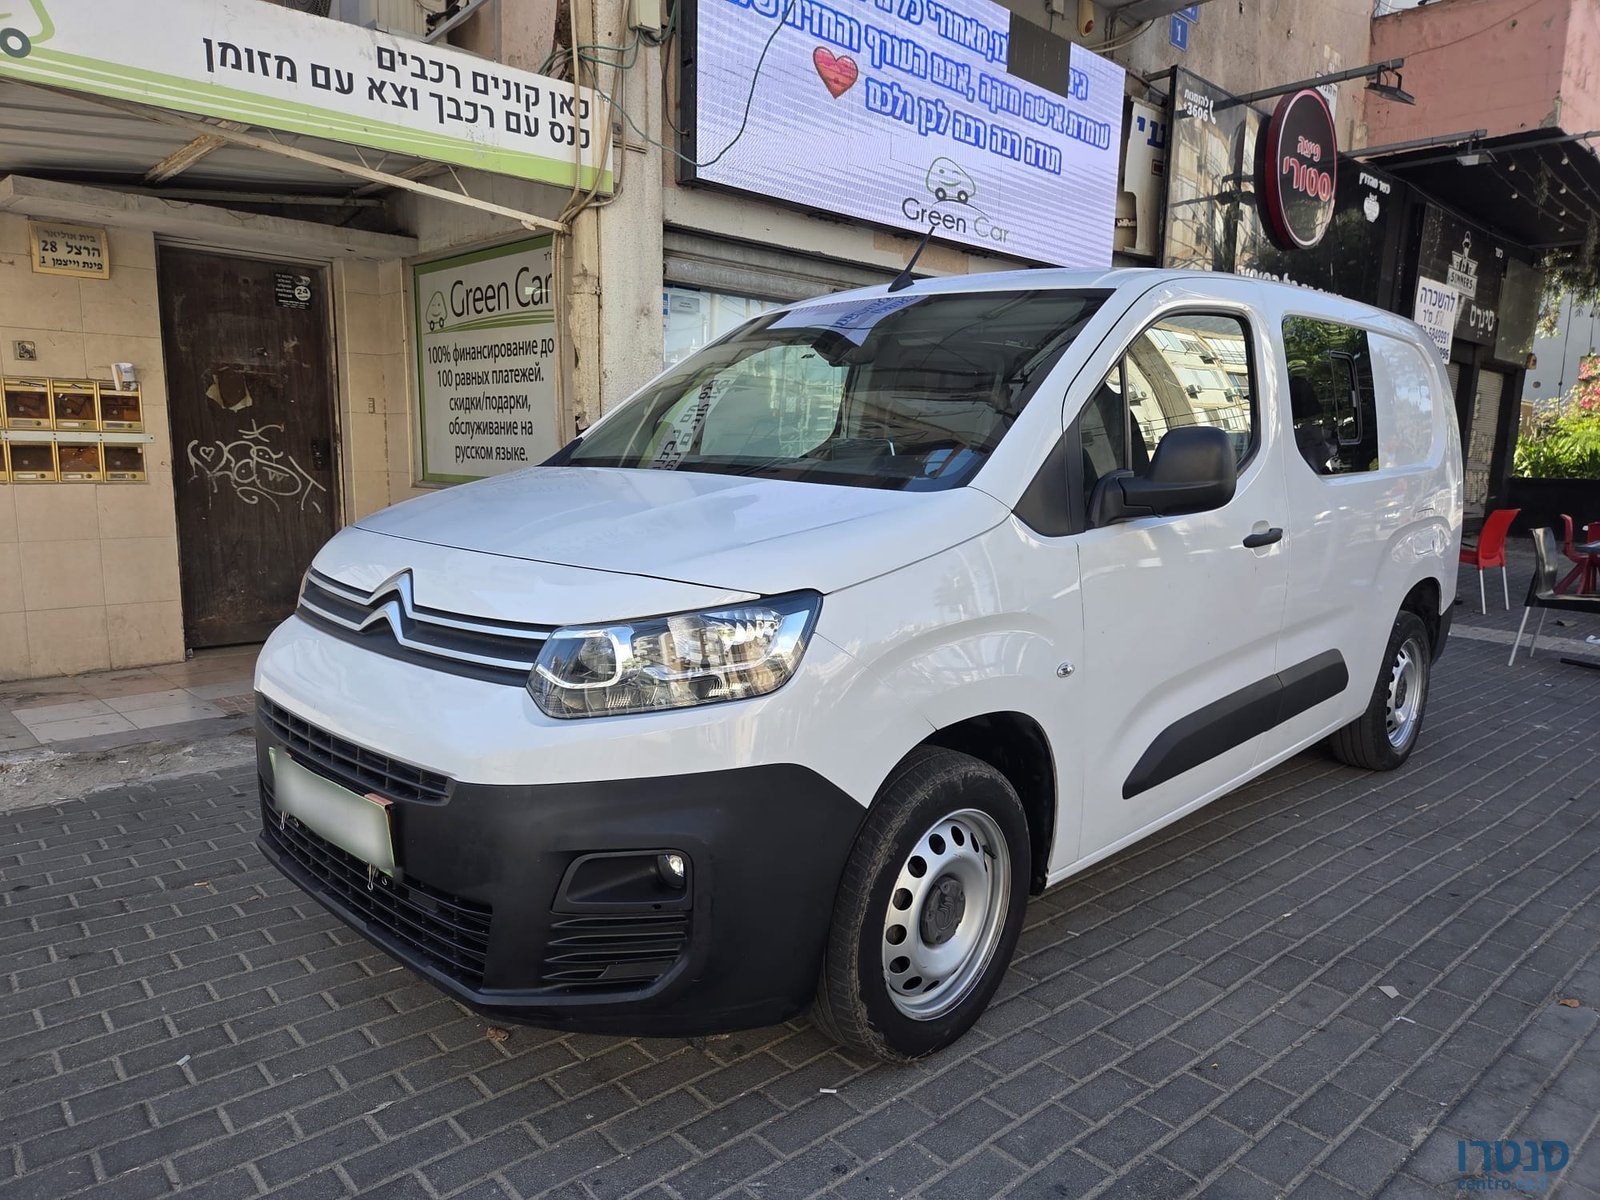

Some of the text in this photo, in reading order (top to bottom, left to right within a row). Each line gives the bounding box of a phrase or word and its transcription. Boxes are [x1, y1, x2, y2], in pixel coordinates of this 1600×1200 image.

[865, 24, 928, 79] העורף
[203, 38, 591, 149] כנס עם רכבך וצא עם מזומן
[376, 46, 590, 120] כאן קונים רכבים
[978, 72, 1021, 117] חזקה
[866, 76, 1062, 175] תודה רבה רבה לכן ולכם
[1023, 91, 1066, 134] אישה
[1066, 109, 1111, 151] עומדת
[1297, 135, 1322, 163] פיצה
[1283, 156, 1331, 202] סטורי
[79, 233, 96, 242] בית
[902, 197, 1009, 243] Green Car
[41, 240, 101, 257] הרצל 28
[41, 256, 103, 270] פינת וייצמן 1
[450, 267, 553, 317] Green Car
[1420, 286, 1456, 313] להשכרה
[428, 337, 555, 367] 100% финансирование до
[437, 362, 544, 391] 100 равных платежей.
[449, 391, 531, 414] скидки/подарки,
[449, 416, 533, 440] обслуживание на
[455, 445, 528, 464] русском языке.
